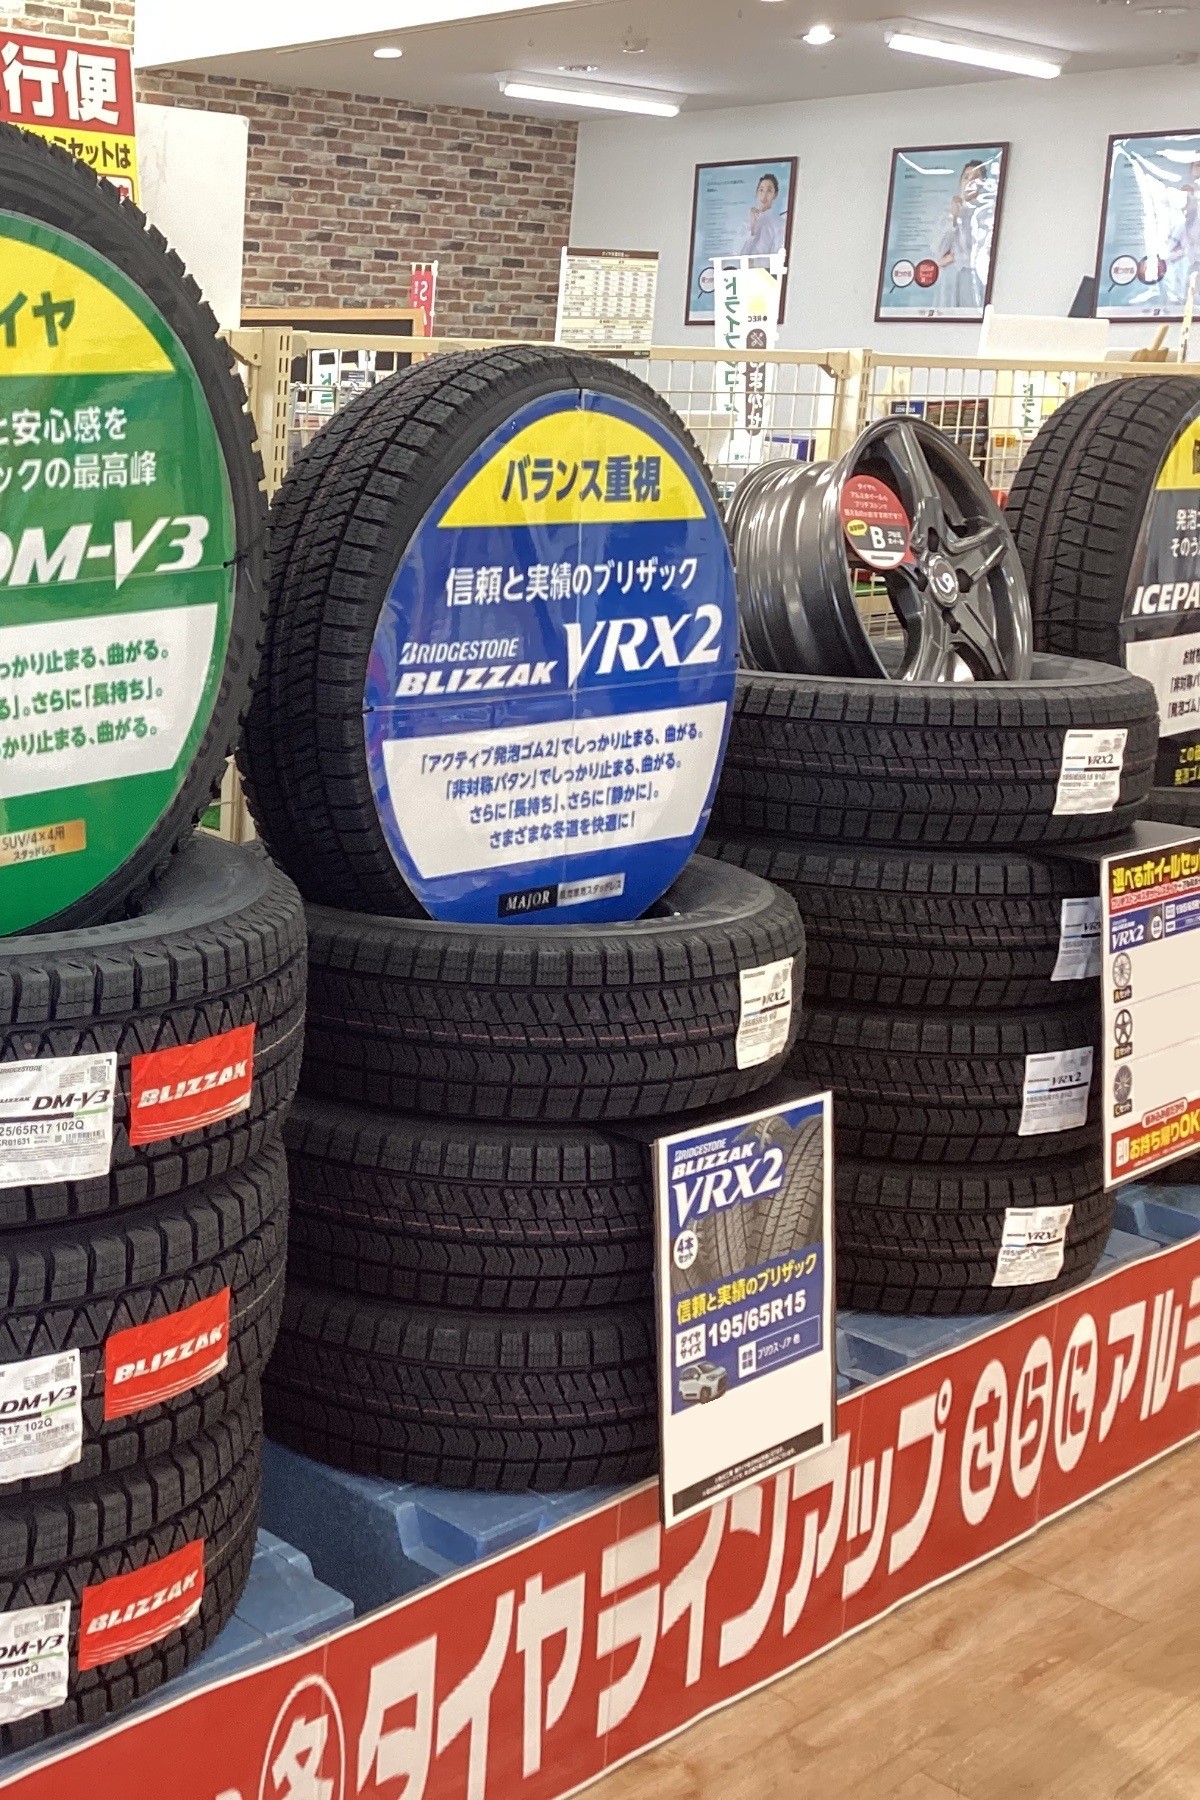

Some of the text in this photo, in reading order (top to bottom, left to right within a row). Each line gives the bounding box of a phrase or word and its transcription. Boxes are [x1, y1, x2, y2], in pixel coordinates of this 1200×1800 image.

[501, 455, 662, 502] バランス重視
[870, 526, 886, 549] B
[1171, 538, 1200, 558] そのう
[446, 557, 697, 608] 信頼と実績のブリザック
[396, 605, 722, 697] BLIZZAK VRX2
[400, 636, 519, 665] BRIDGESTONE
[1088, 754, 1114, 766] VRX2
[506, 890, 551, 910] MAJOR
[1112, 924, 1145, 950] VRX2
[762, 988, 786, 1006] VRX2
[137, 1059, 248, 1109] BLIZZAK
[1052, 1071, 1081, 1086] VRX2
[32, 1089, 111, 1111] DM-V3
[56, 1120, 85, 1133] 102Q
[671, 1142, 755, 1181] BLIZZAK
[674, 1138, 727, 1163] BRIDGESTONE
[672, 1147, 785, 1228] VRX2
[676, 1252, 817, 1325] 信頼と実績のブリザック
[708, 1289, 807, 1347] 195/65R15
[113, 1322, 225, 1385] BLIZZAK
[0, 1385, 77, 1415] DM-V3
[25, 1417, 53, 1432] 102Q
[86, 1569, 199, 1635] BLIZZAK
[12, 1663, 39, 1678] 102Q
